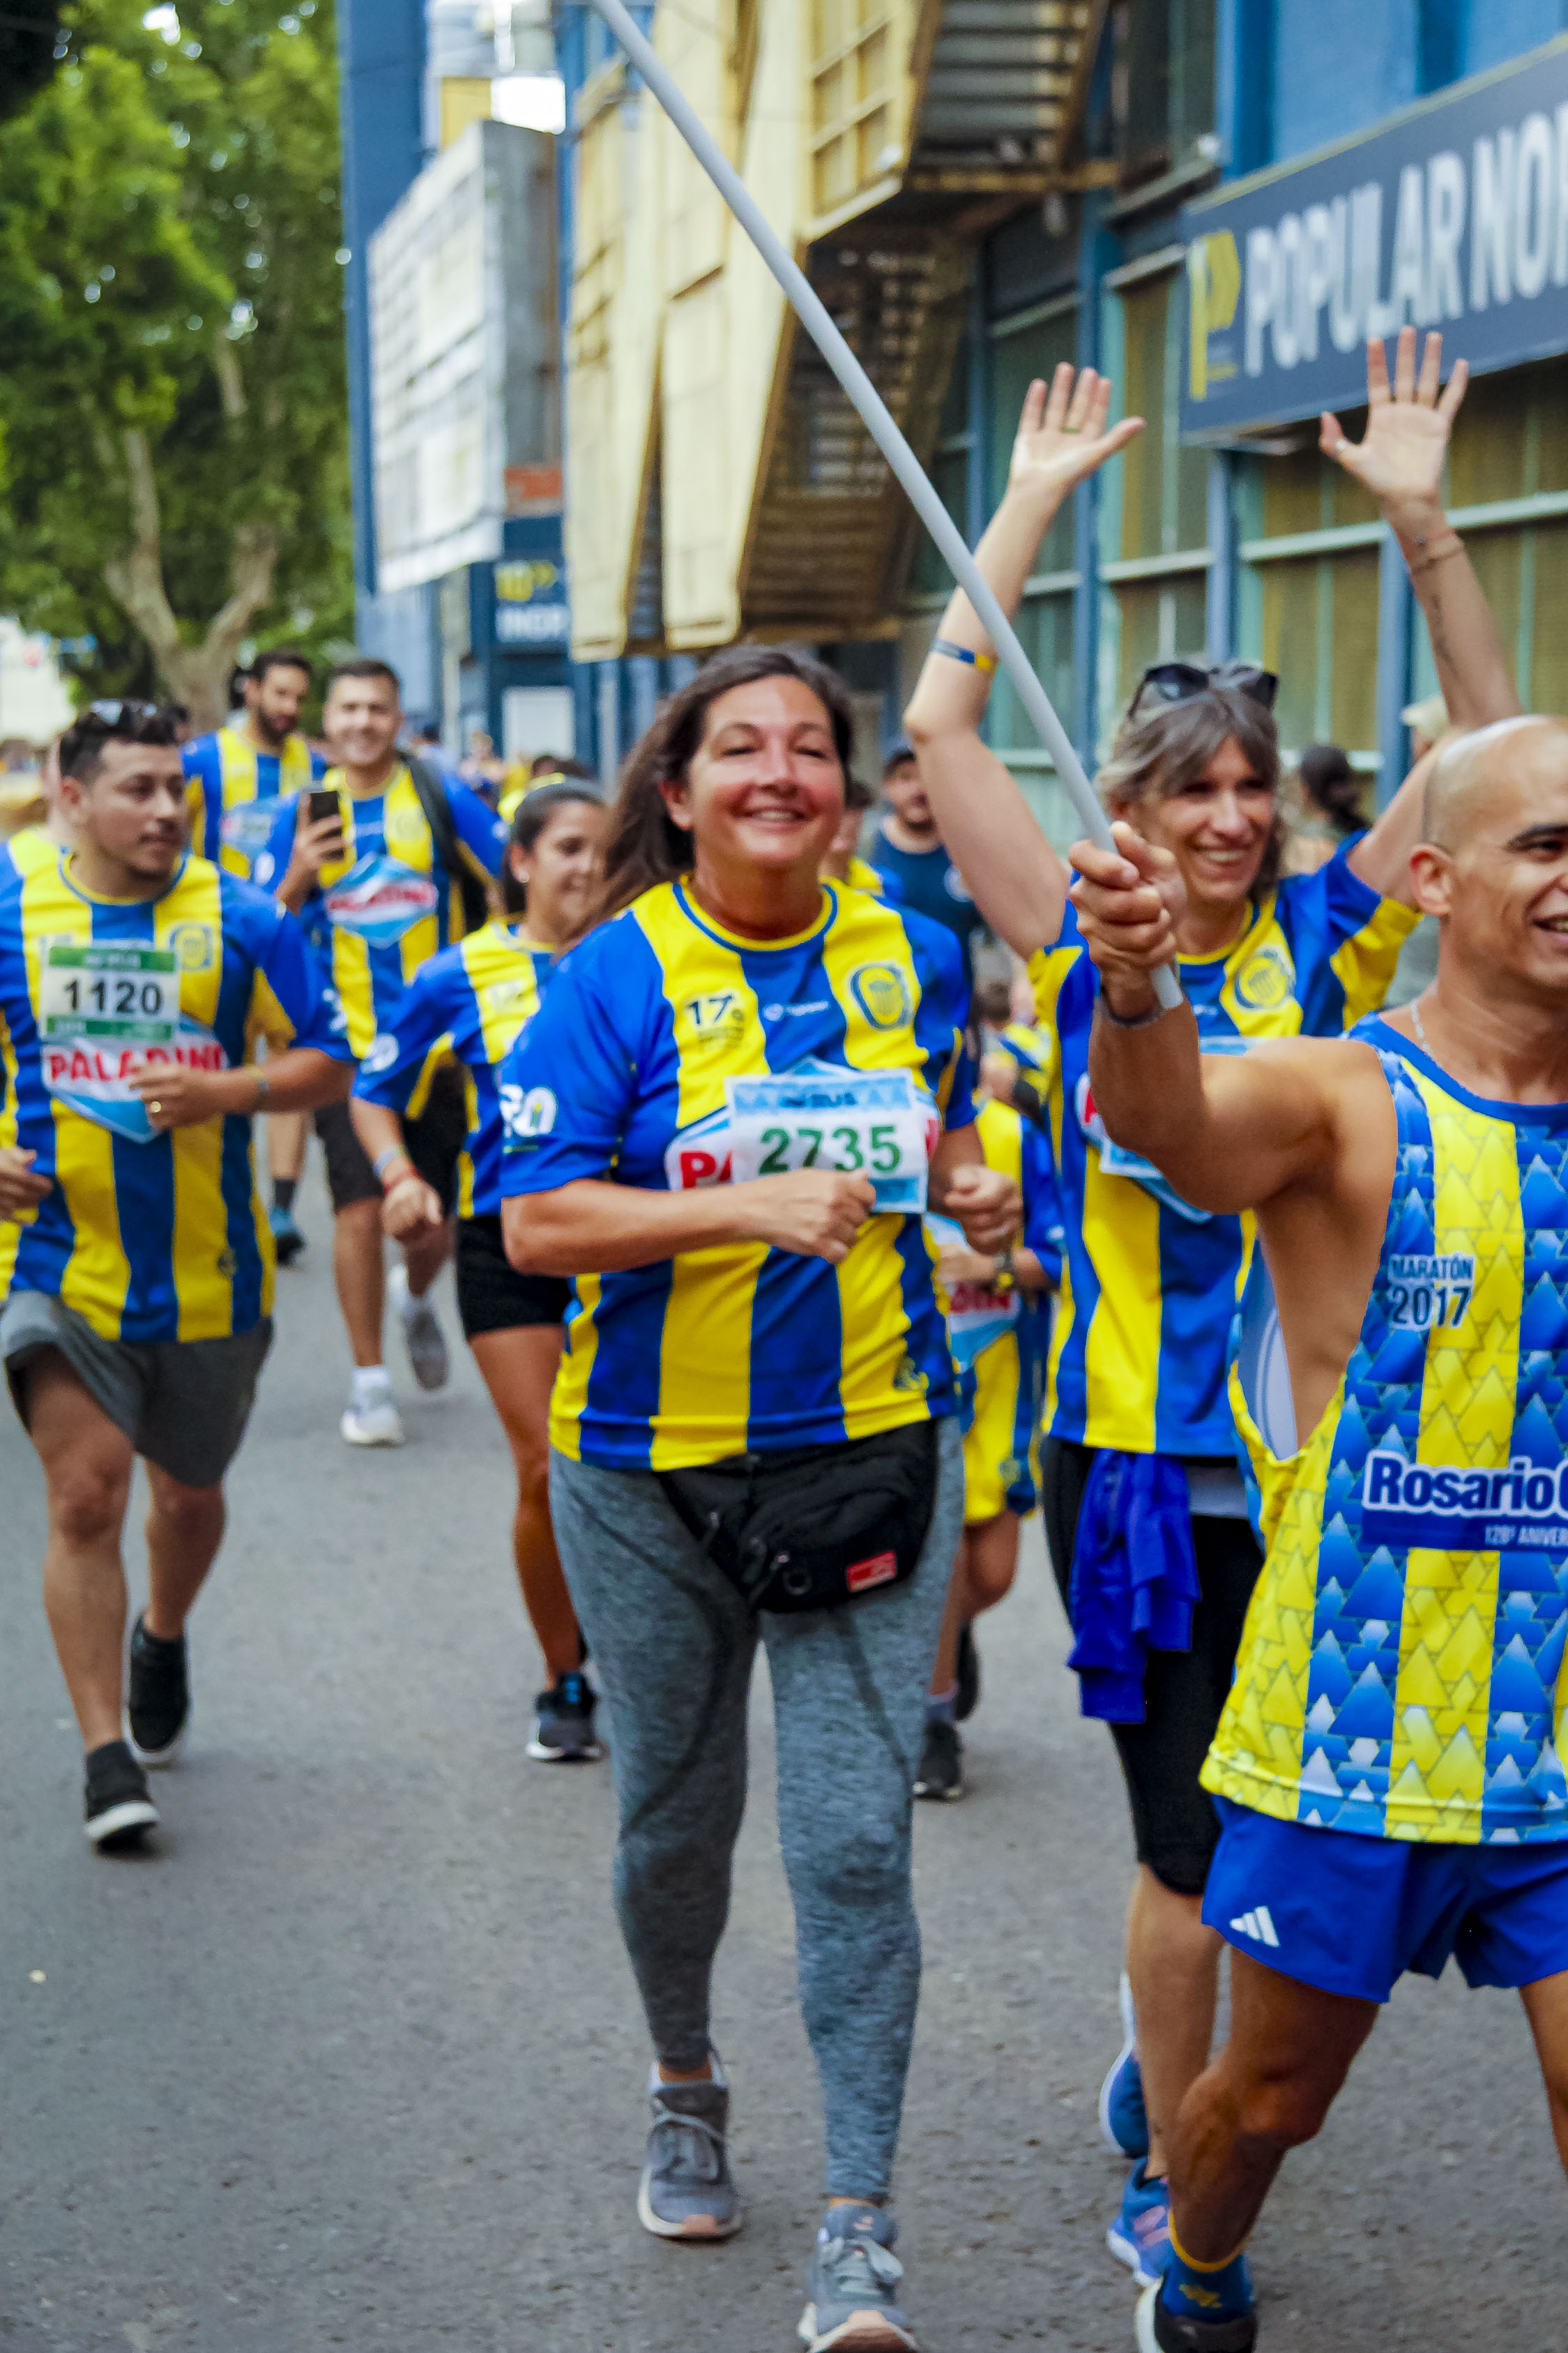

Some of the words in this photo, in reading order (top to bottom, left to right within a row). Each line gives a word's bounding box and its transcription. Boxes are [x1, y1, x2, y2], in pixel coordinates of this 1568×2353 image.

[1244, 151, 1464, 377] POPULAR
[66, 978, 162, 1015] 1120
[758, 1125, 901, 1174] 2735
[1392, 1285, 1470, 1327] 2017
